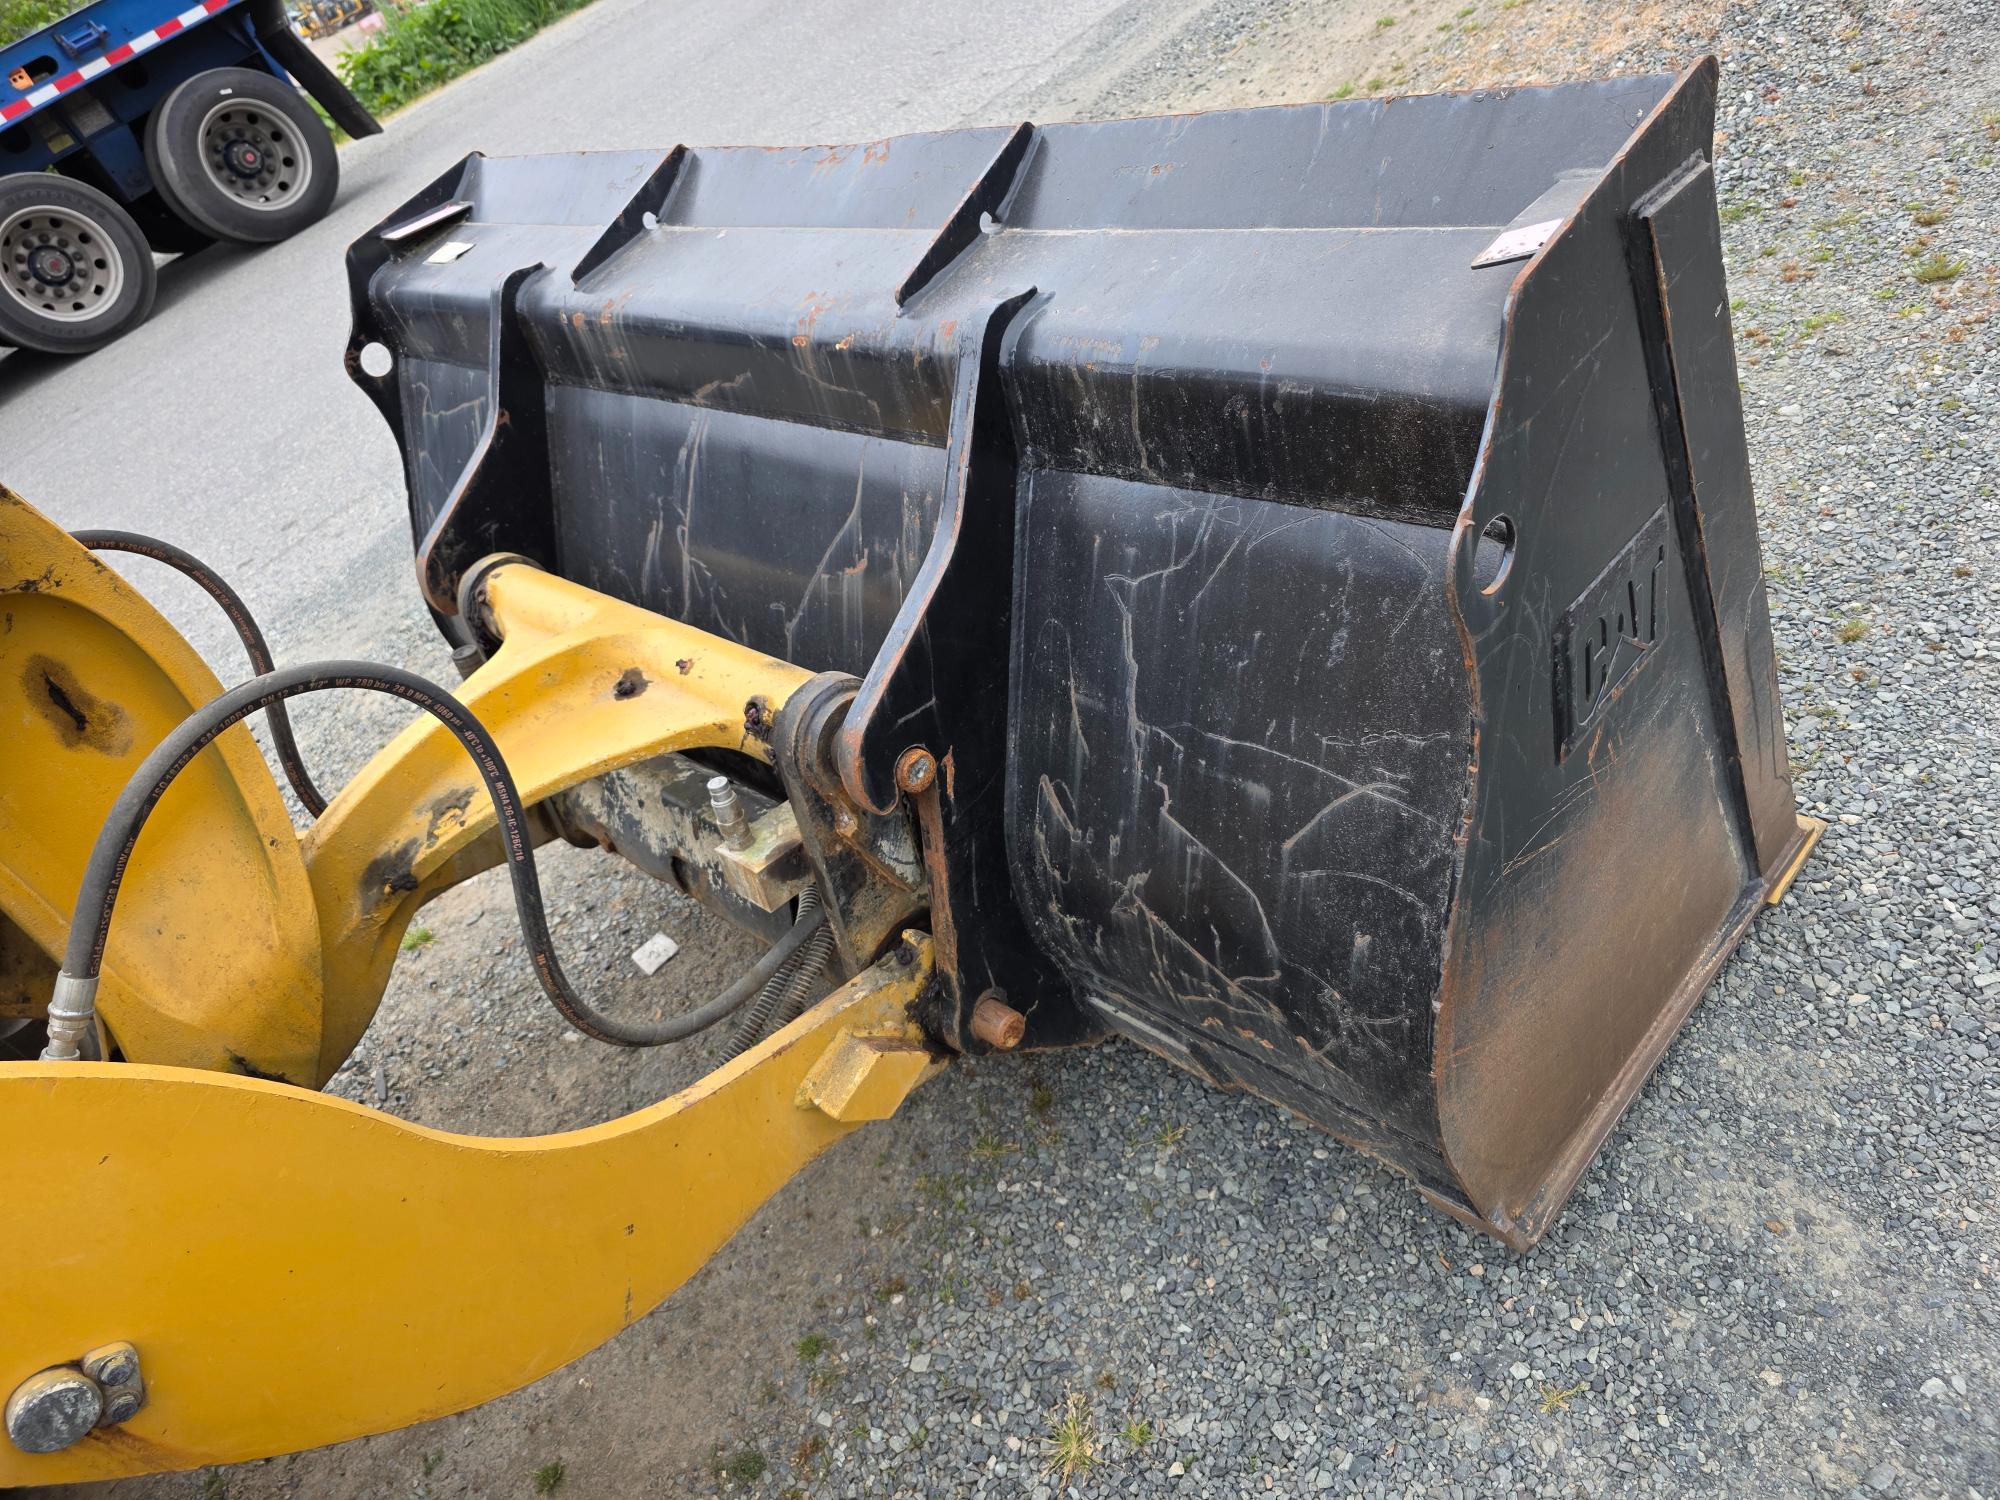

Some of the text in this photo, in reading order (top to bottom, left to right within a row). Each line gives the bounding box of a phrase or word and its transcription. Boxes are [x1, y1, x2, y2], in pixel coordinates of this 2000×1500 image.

[1574, 538, 1667, 727] CAT
[111, 837, 136, 886] AntiWear
[152, 781, 169, 799] ISO
[335, 678, 352, 687] WP
[355, 678, 374, 688] 280
[373, 680, 390, 689] bar
[414, 691, 433, 705] MPa
[434, 703, 454, 719] 4060
[450, 715, 464, 727] psi
[474, 744, 484, 755] to
[495, 781, 511, 805] MSHA
